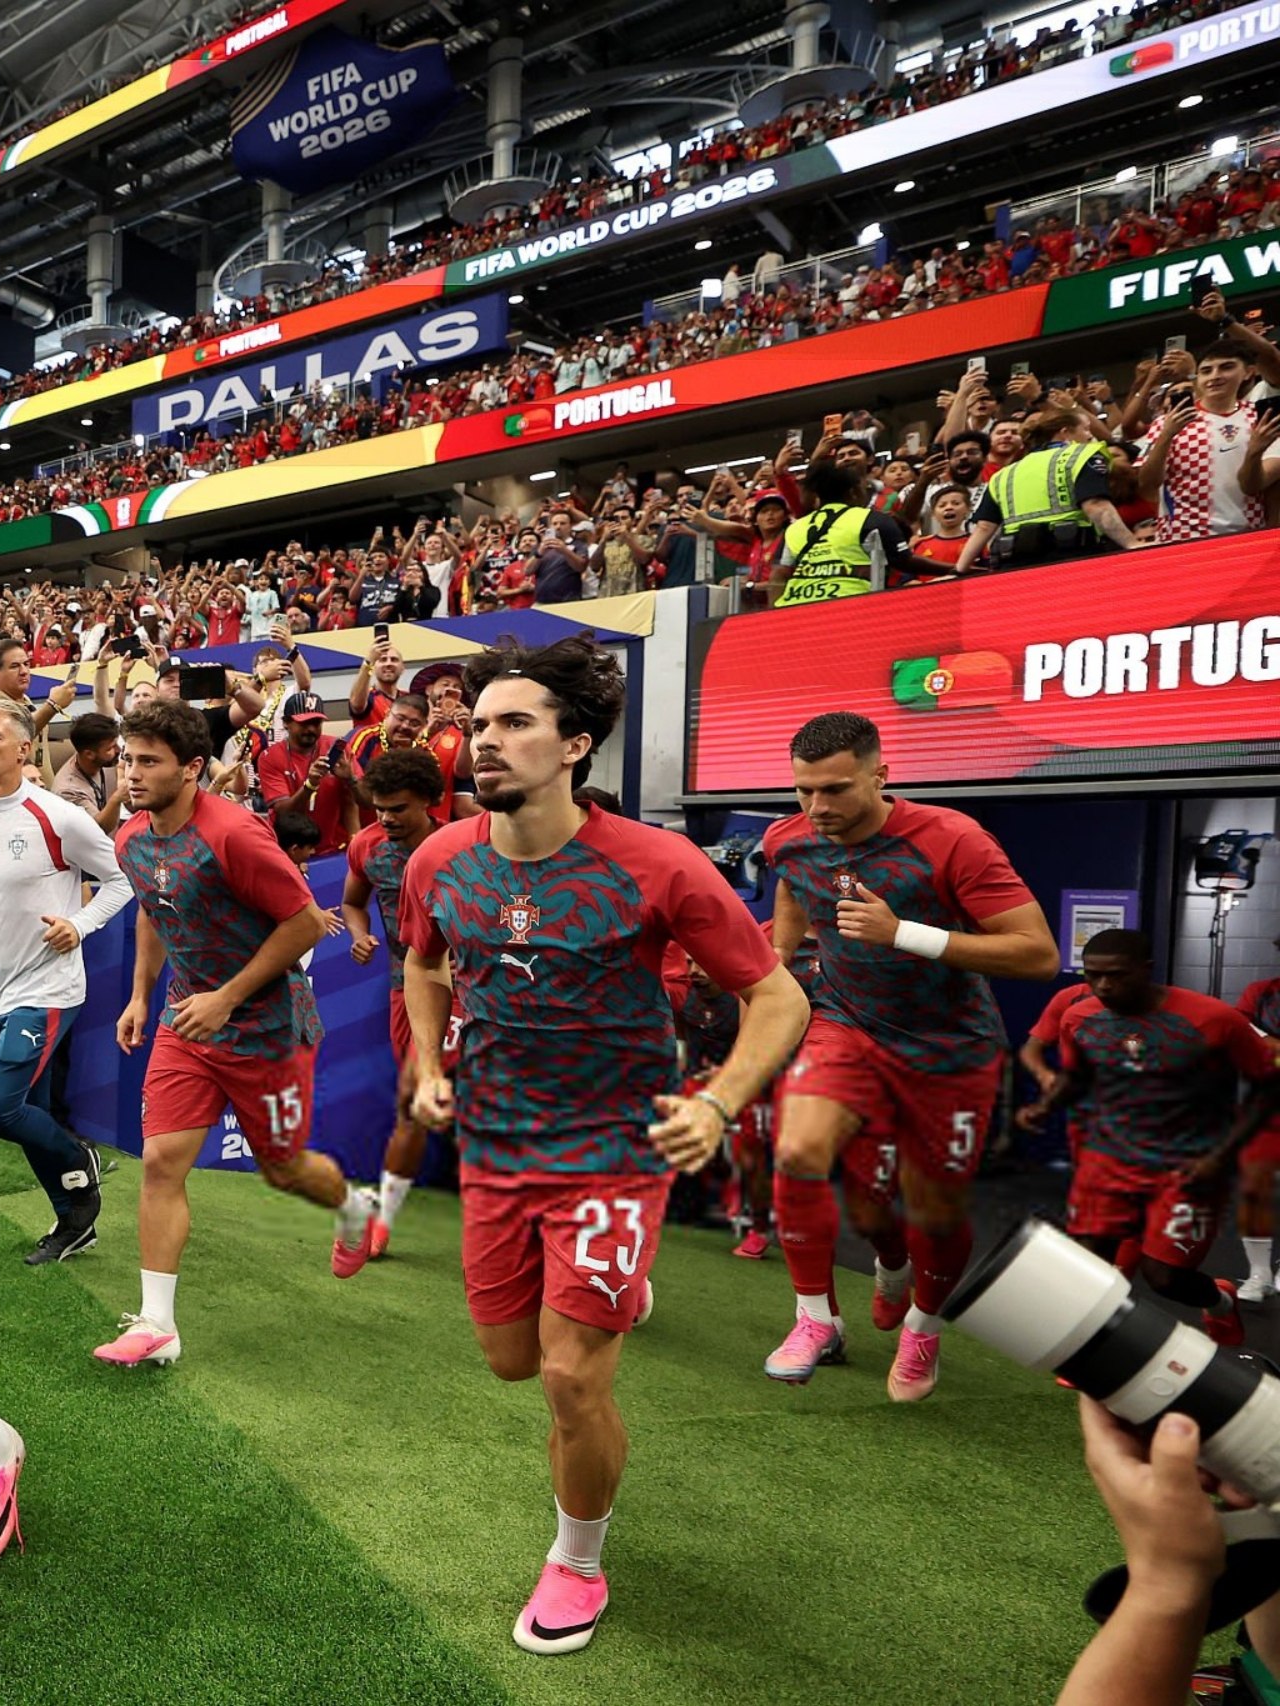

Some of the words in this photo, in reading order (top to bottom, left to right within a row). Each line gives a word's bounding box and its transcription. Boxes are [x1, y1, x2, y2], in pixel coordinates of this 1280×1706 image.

[225, 10, 288, 55] PORTUGAL
[268, 88, 359, 143] WORLD
[361, 68, 418, 107] CUP
[306, 62, 363, 100] FIFA
[299, 109, 392, 158] 2026
[464, 250, 516, 283] FIFA
[517, 220, 609, 266] WORLD
[618, 201, 668, 234] CUP
[670, 168, 778, 221] 2026
[1109, 254, 1234, 310] FIFA
[220, 323, 282, 356] PORTUGAL
[157, 310, 479, 434] DALLAS
[555, 379, 675, 429] PORTUGAL
[1023, 616, 1280, 702] PORTUG
[261, 1083, 303, 1137] 15
[948, 1111, 976, 1158] 5
[572, 1199, 645, 1275] 23
